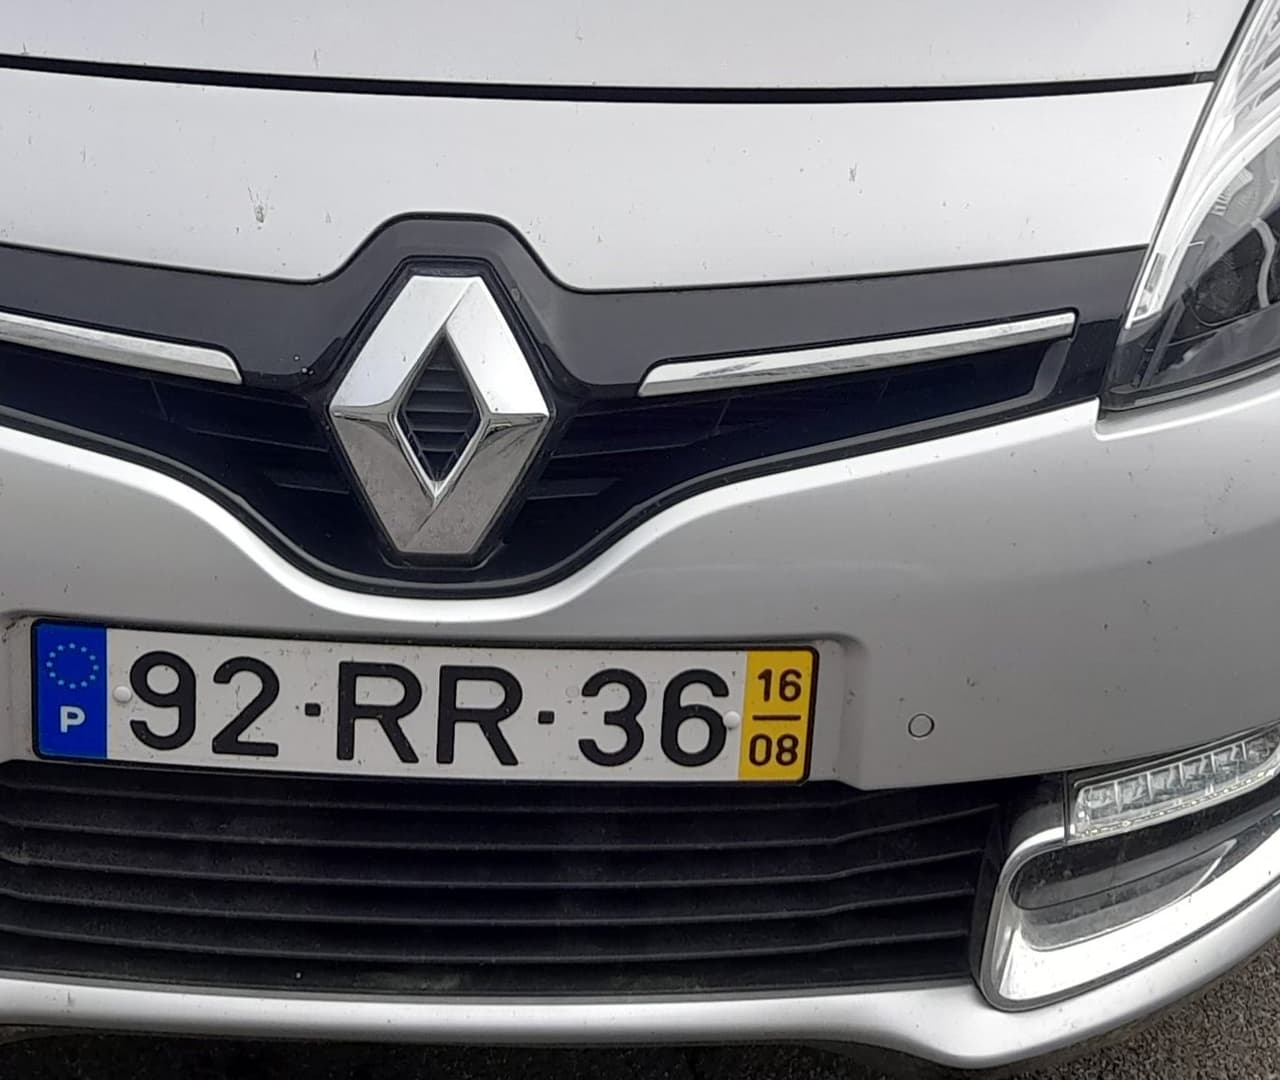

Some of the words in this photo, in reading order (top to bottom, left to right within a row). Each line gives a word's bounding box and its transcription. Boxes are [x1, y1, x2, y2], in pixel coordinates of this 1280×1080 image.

[757, 668, 802, 702] 16
[59, 705, 86, 734] P
[749, 733, 799, 767] 08
